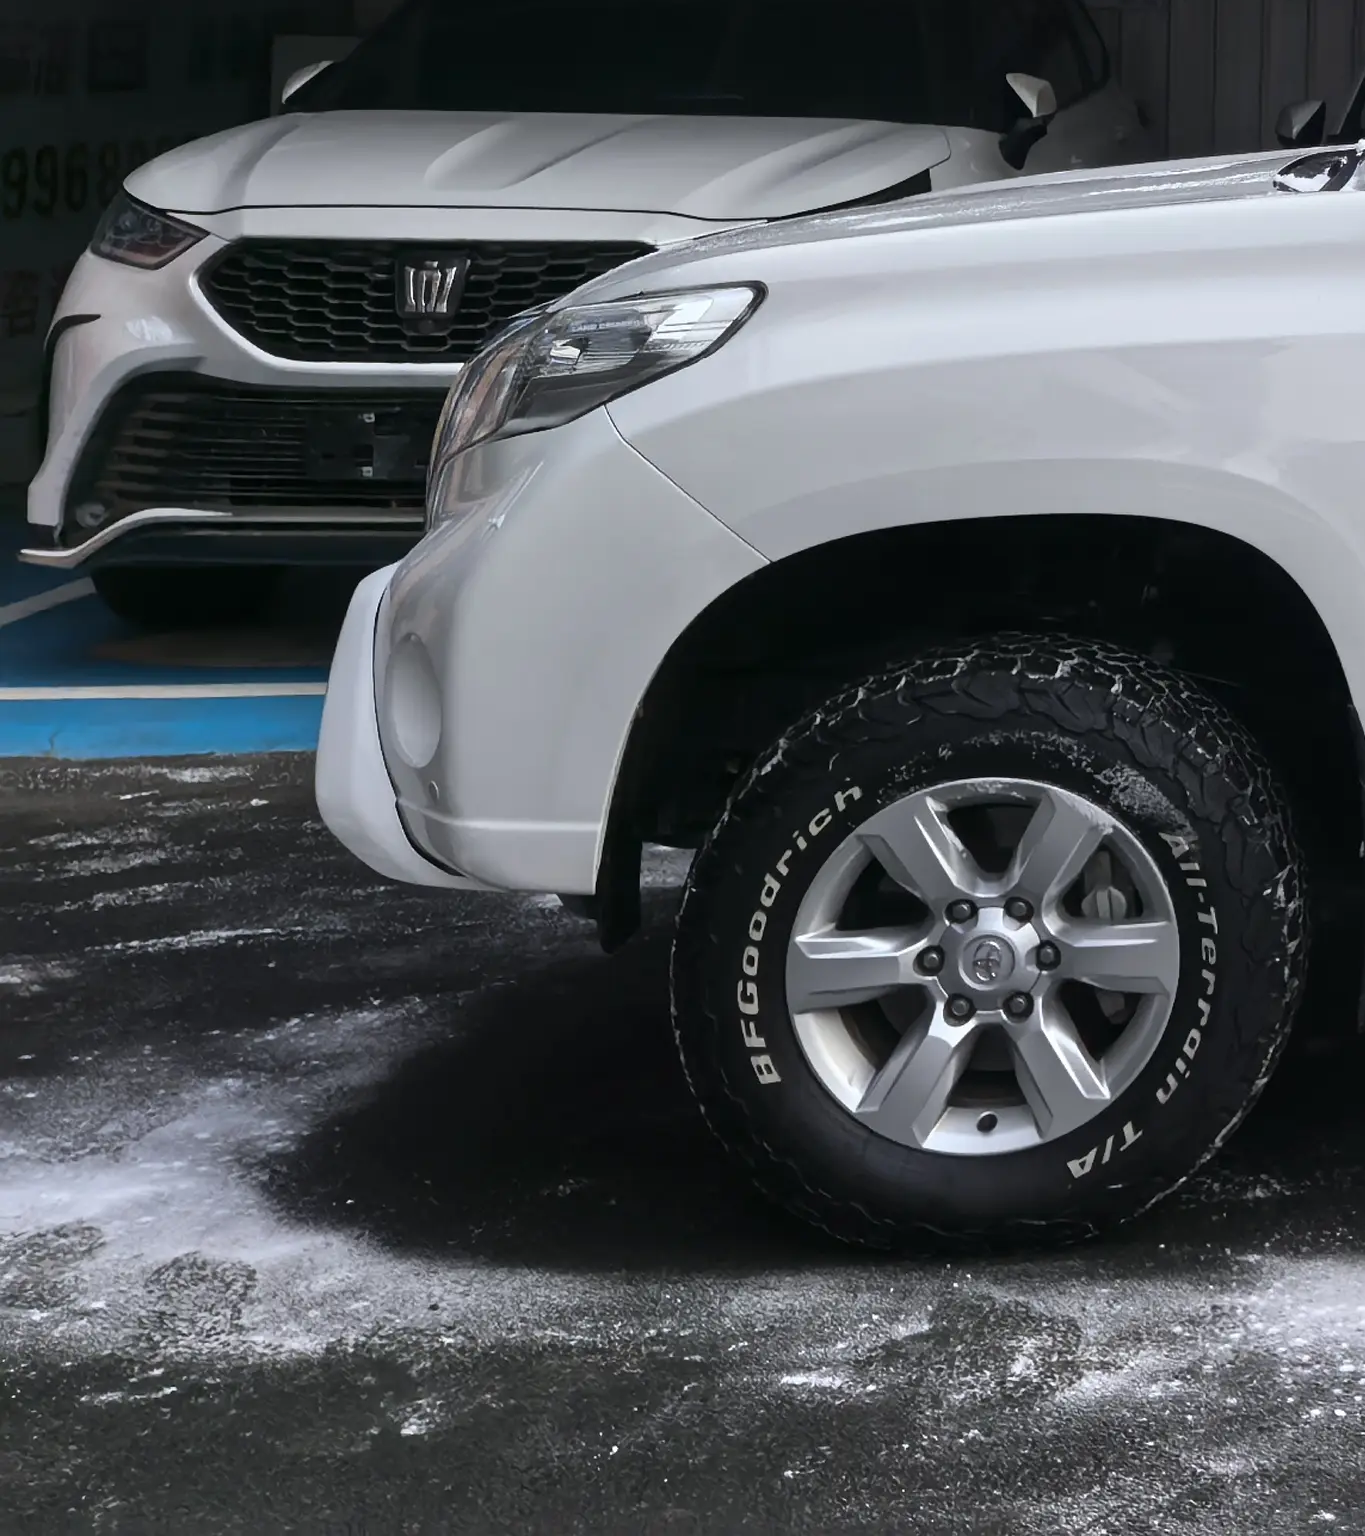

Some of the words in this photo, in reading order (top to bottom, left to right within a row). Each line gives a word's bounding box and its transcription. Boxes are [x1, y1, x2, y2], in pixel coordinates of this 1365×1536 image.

[738, 783, 864, 1085] BFGoodrich
[1158, 830, 1220, 1105] All-Terrain
[1066, 1119, 1146, 1179] T/A
